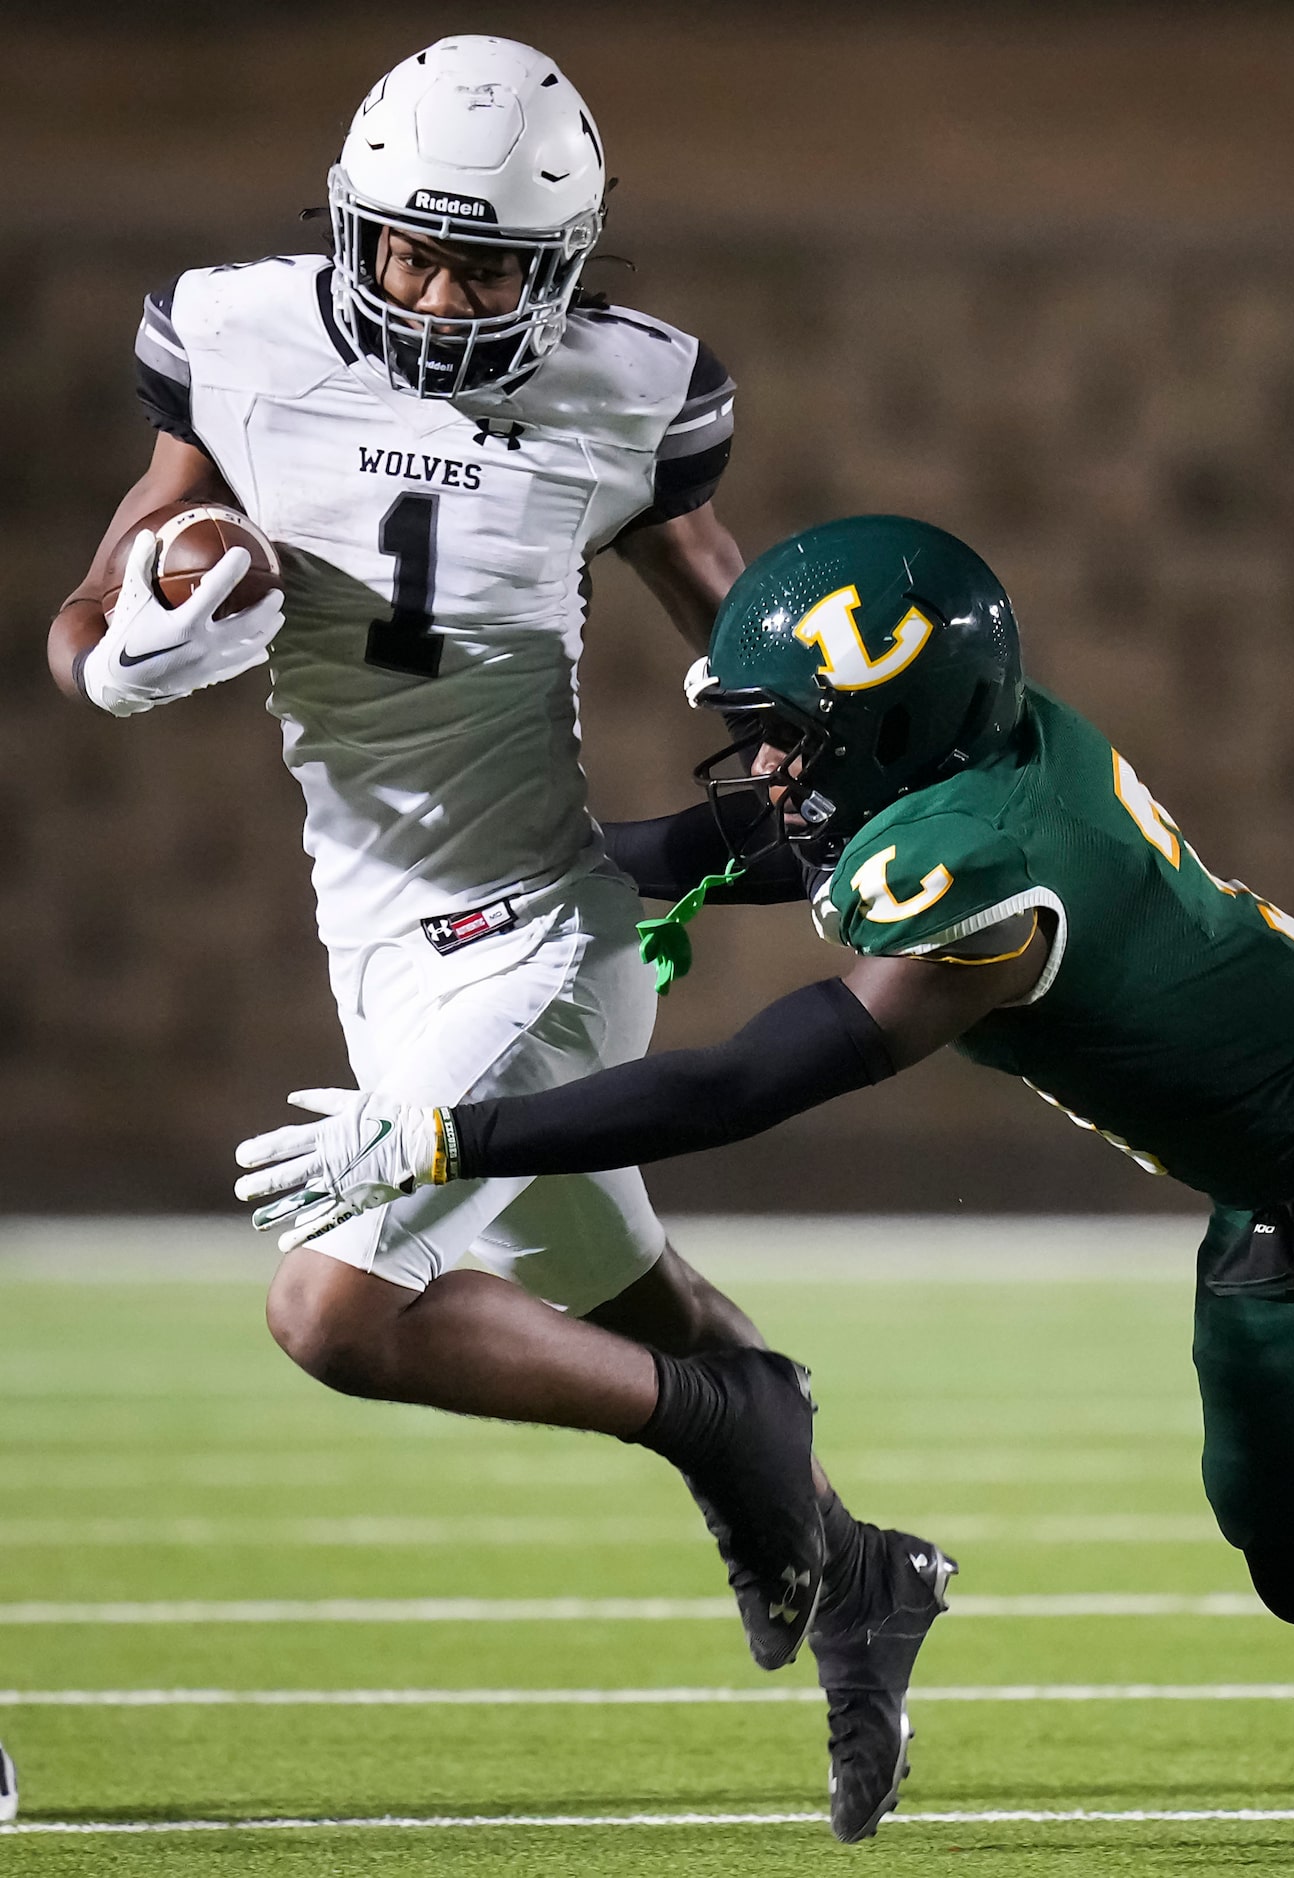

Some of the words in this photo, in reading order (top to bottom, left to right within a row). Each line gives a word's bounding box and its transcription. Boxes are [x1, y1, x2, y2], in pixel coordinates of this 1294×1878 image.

[416, 191, 485, 217] Riddell
[359, 447, 482, 490] WOLVES
[365, 491, 445, 679] 1
[793, 583, 934, 692] L
[850, 844, 954, 924] L
